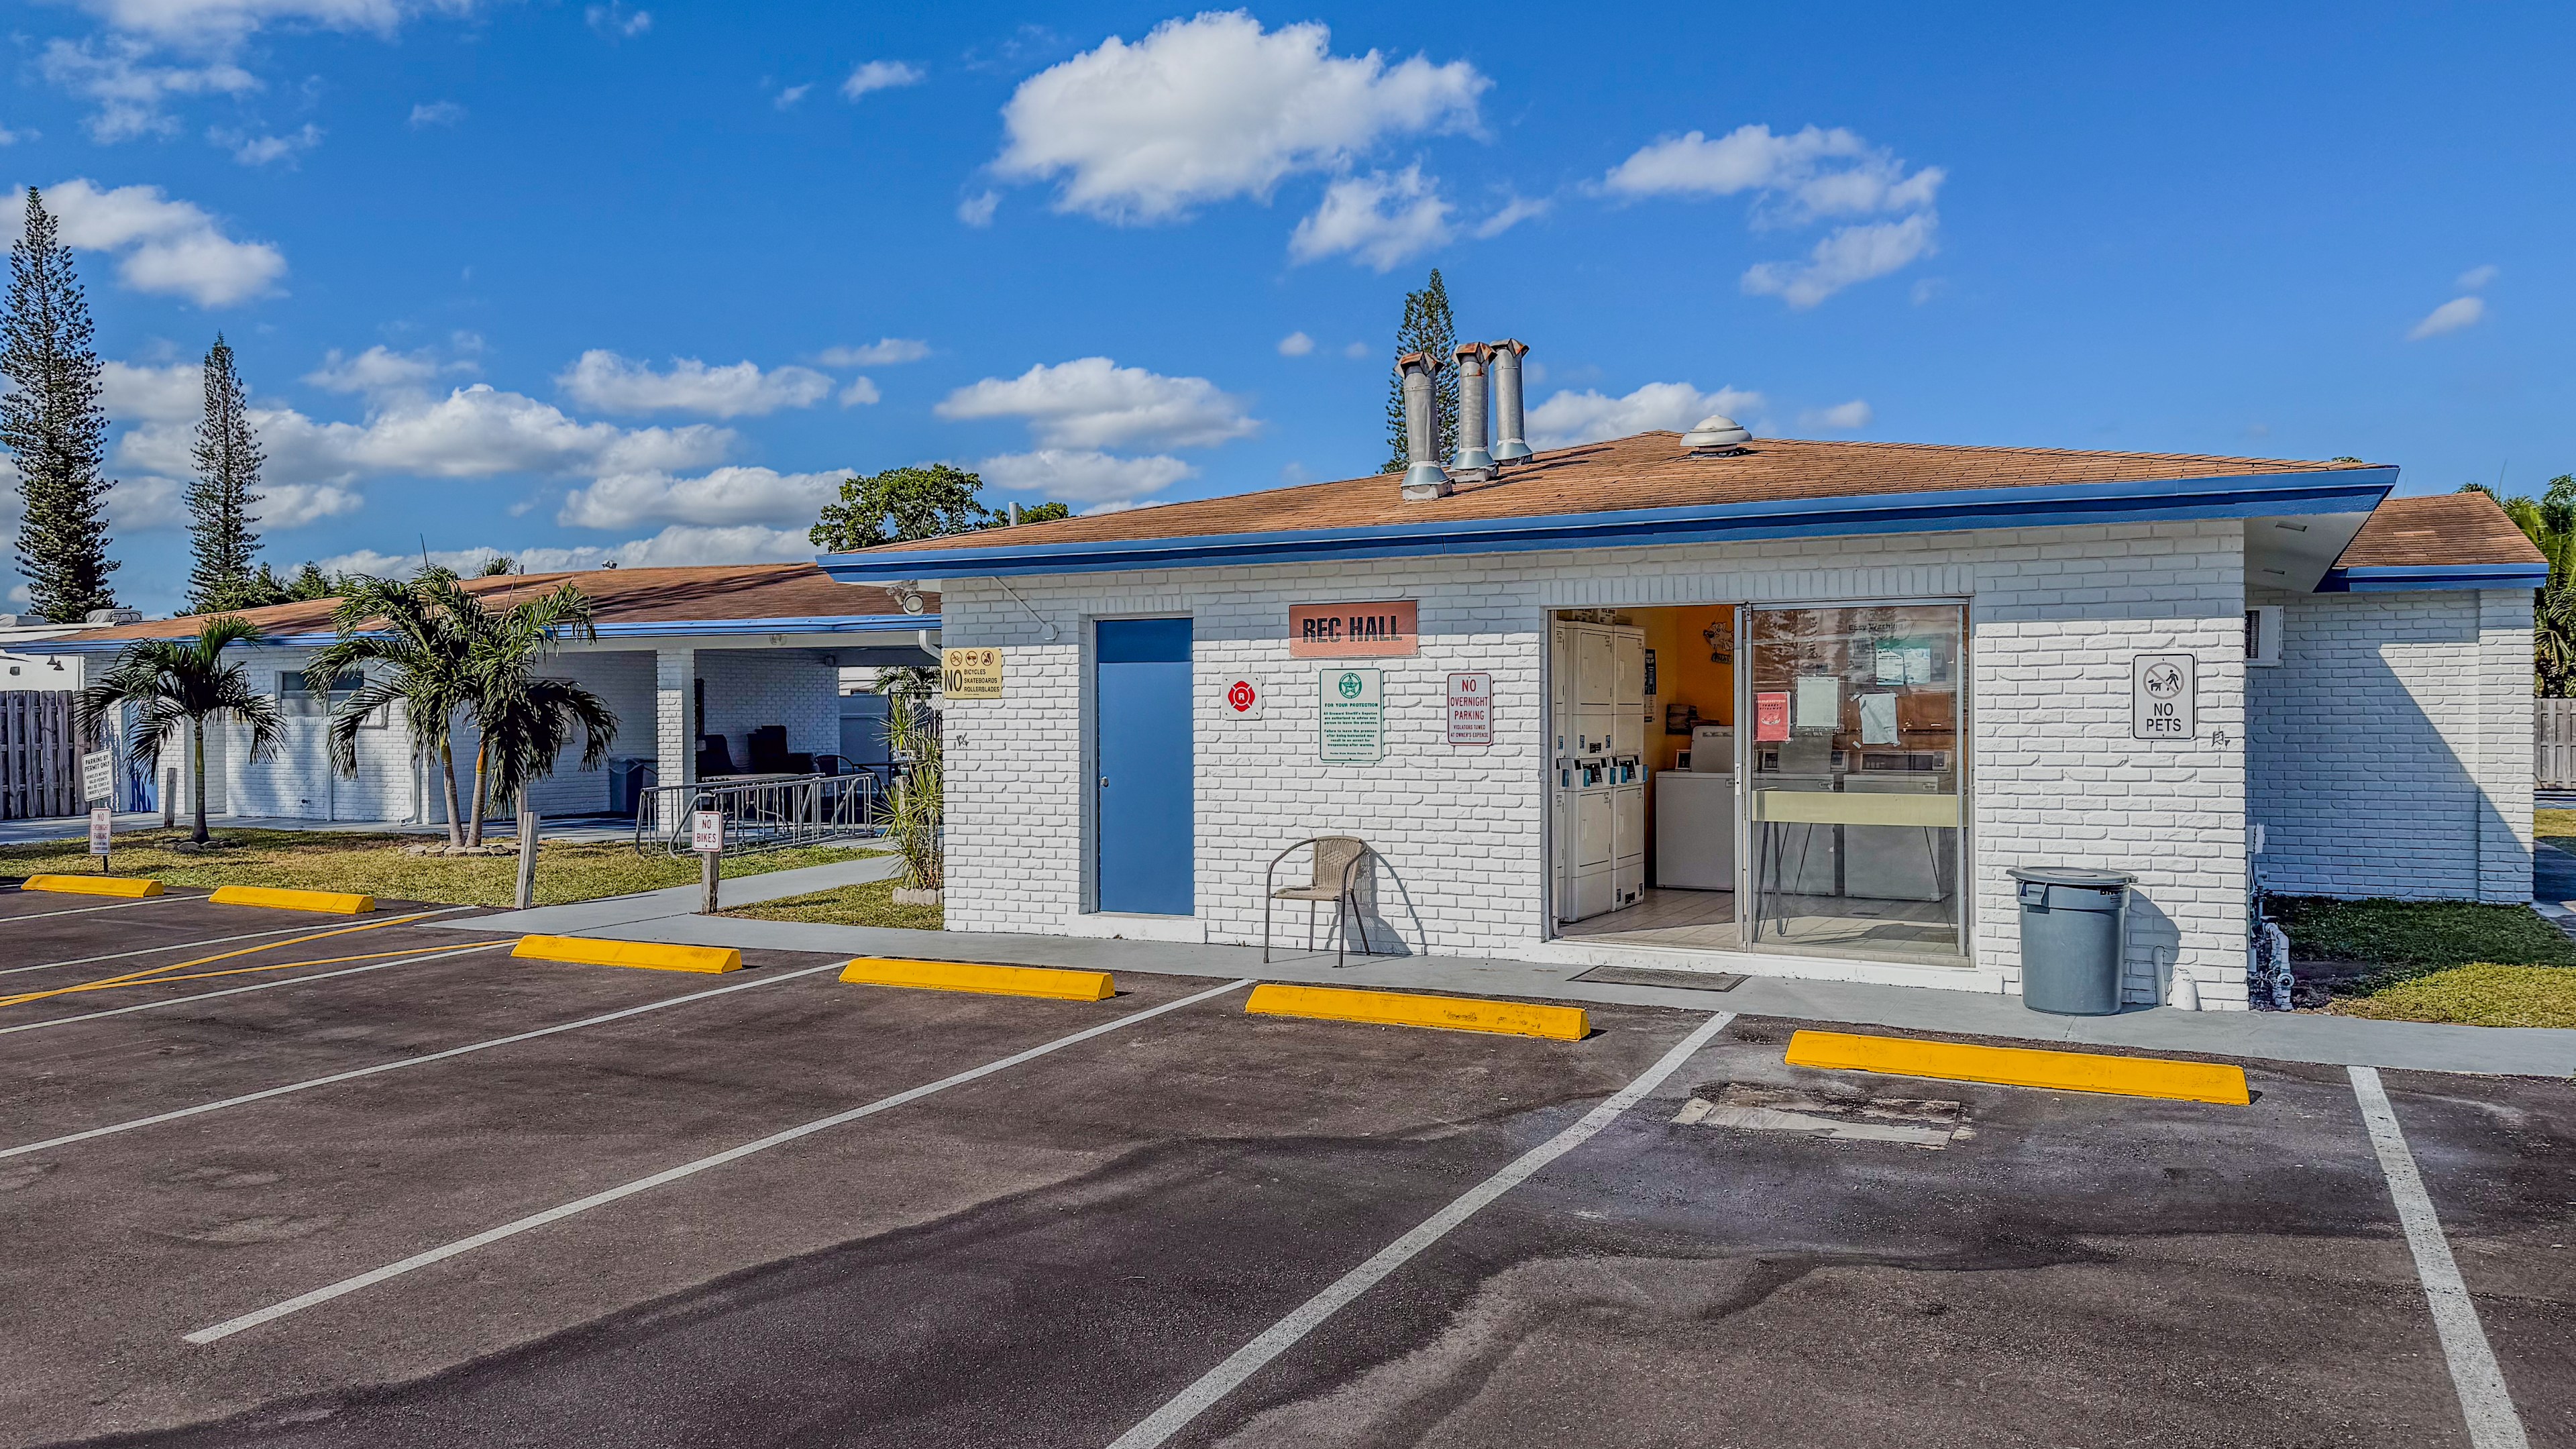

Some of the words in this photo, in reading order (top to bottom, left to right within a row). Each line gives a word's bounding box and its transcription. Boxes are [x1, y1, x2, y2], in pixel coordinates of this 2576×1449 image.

[1303, 617, 1341, 643] REC
[1349, 615, 1402, 642] HALL
[945, 669, 963, 692] NO
[1462, 679, 1477, 692] NO
[1238, 692, 1245, 700] R
[1450, 696, 1489, 706] OVERNIGHT
[2154, 702, 2174, 716] NO
[1454, 710, 1485, 720] PARKING
[2147, 718, 2181, 732] PETS
[85, 755, 103, 765] PARKING
[85, 763, 99, 772] PERMIT
[97, 812, 105, 822] NO
[702, 819, 712, 829] NO
[696, 833, 716, 843] BIKES
